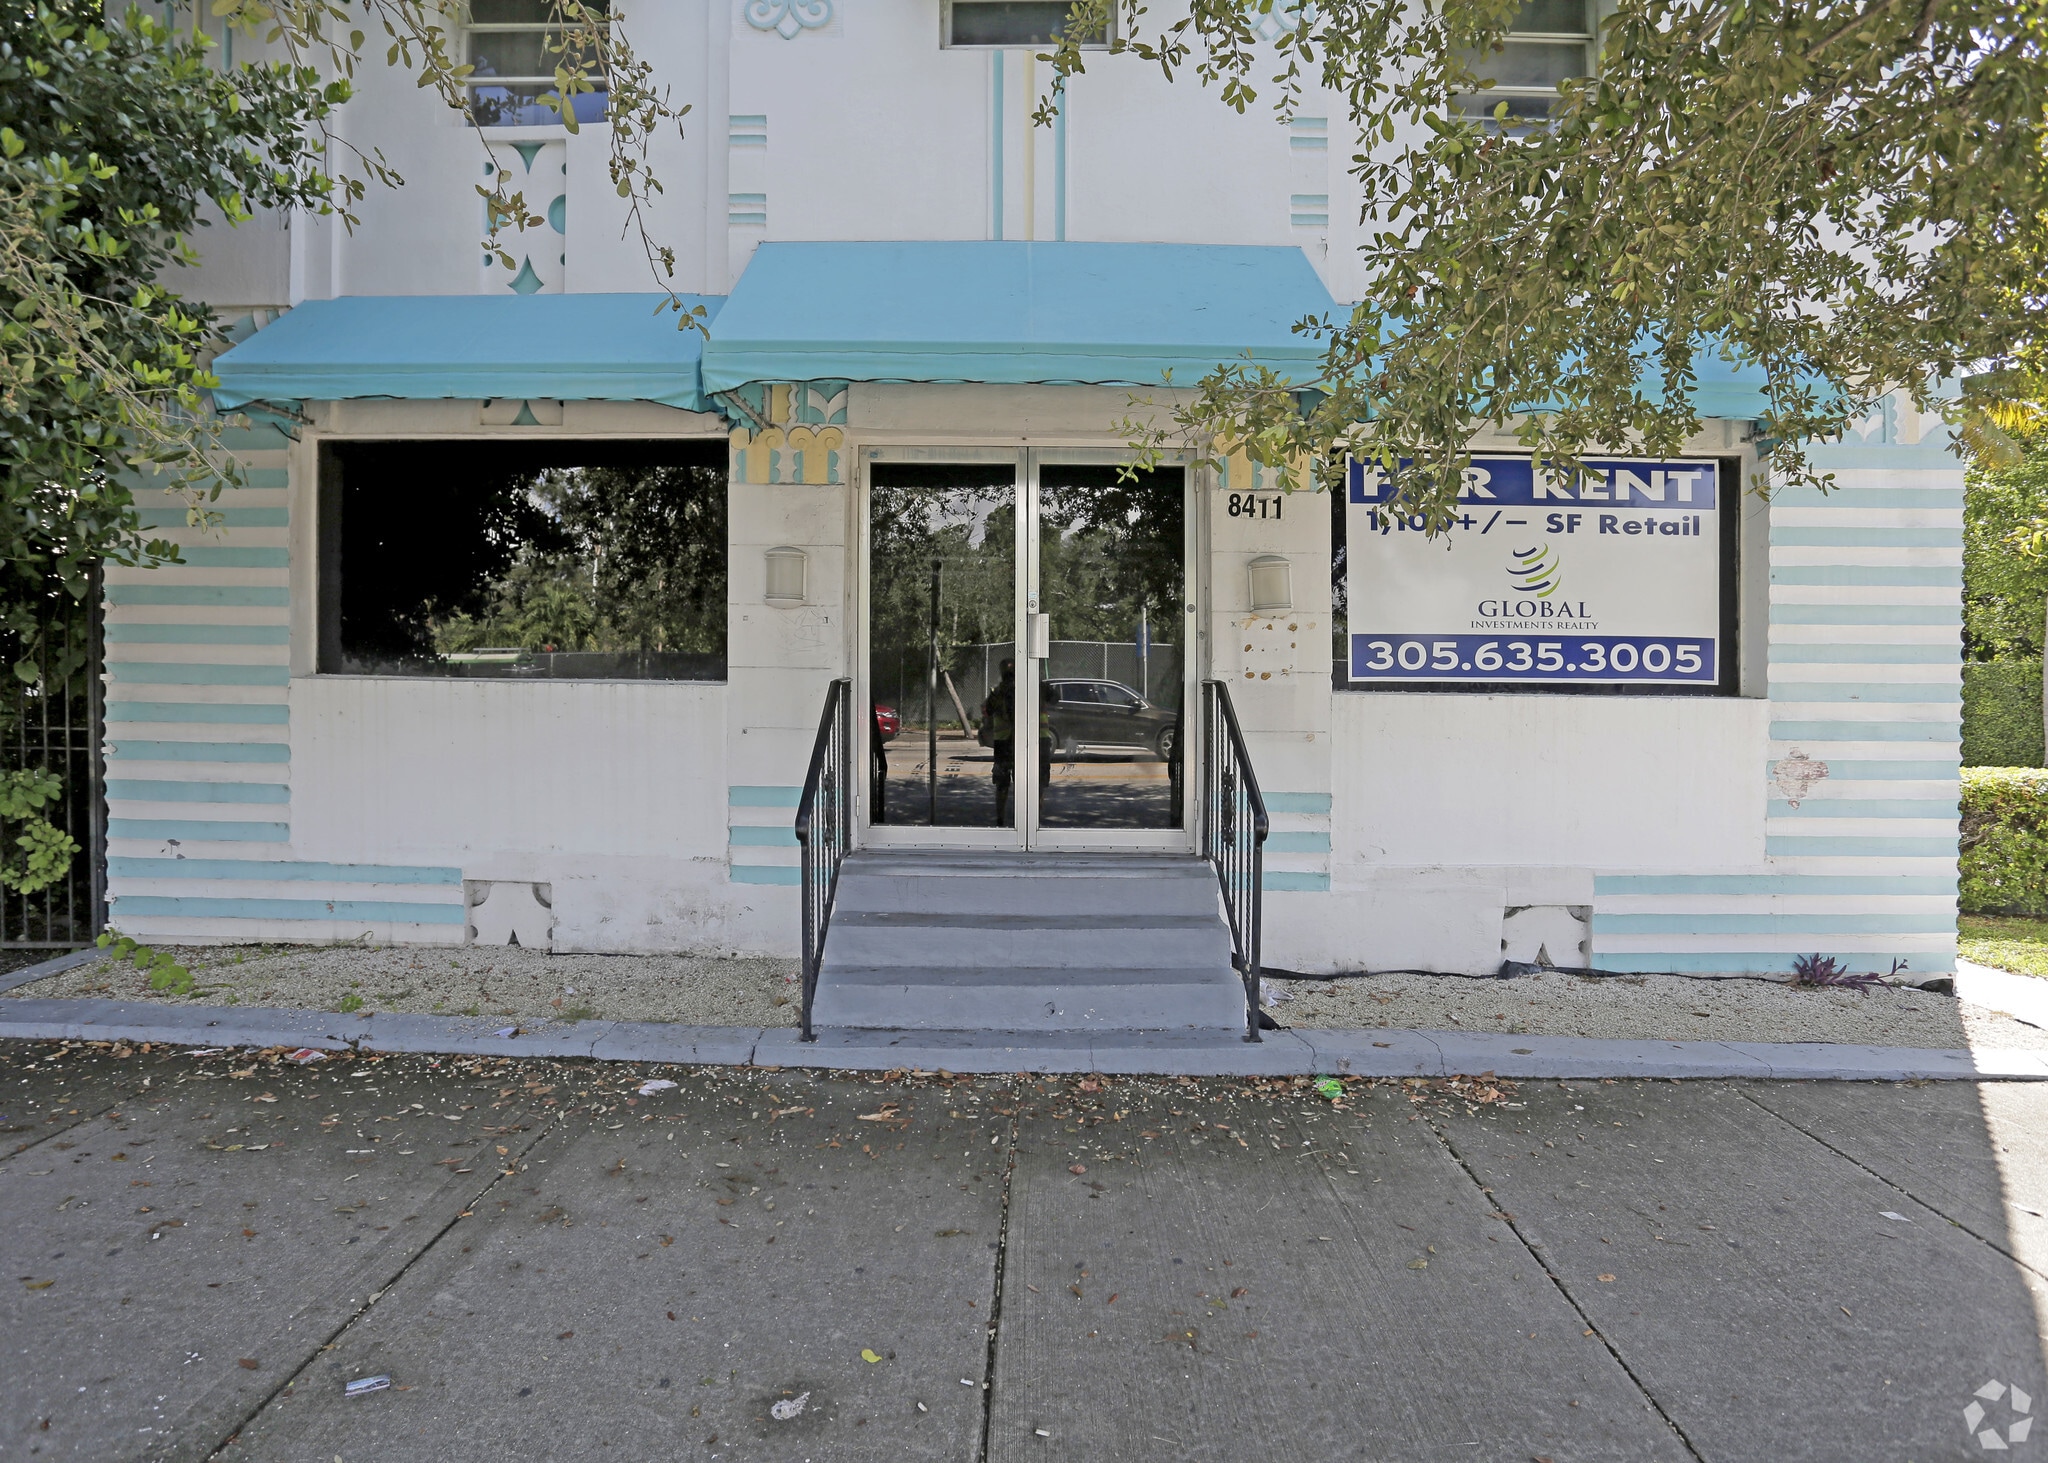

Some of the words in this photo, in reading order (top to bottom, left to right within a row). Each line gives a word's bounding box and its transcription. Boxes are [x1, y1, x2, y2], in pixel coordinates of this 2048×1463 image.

[1364, 465, 1497, 499] FR
[1532, 469, 1702, 502] RENT
[1228, 493, 1282, 520] 8411
[1546, 513, 1582, 534] SF
[1600, 514, 1700, 536] Retail
[1478, 600, 1591, 618] GLOBAL
[1471, 620, 1553, 629] INVESTMENTS
[1557, 621, 1599, 630] REALTY
[1366, 641, 1702, 674] 305.635.3005
